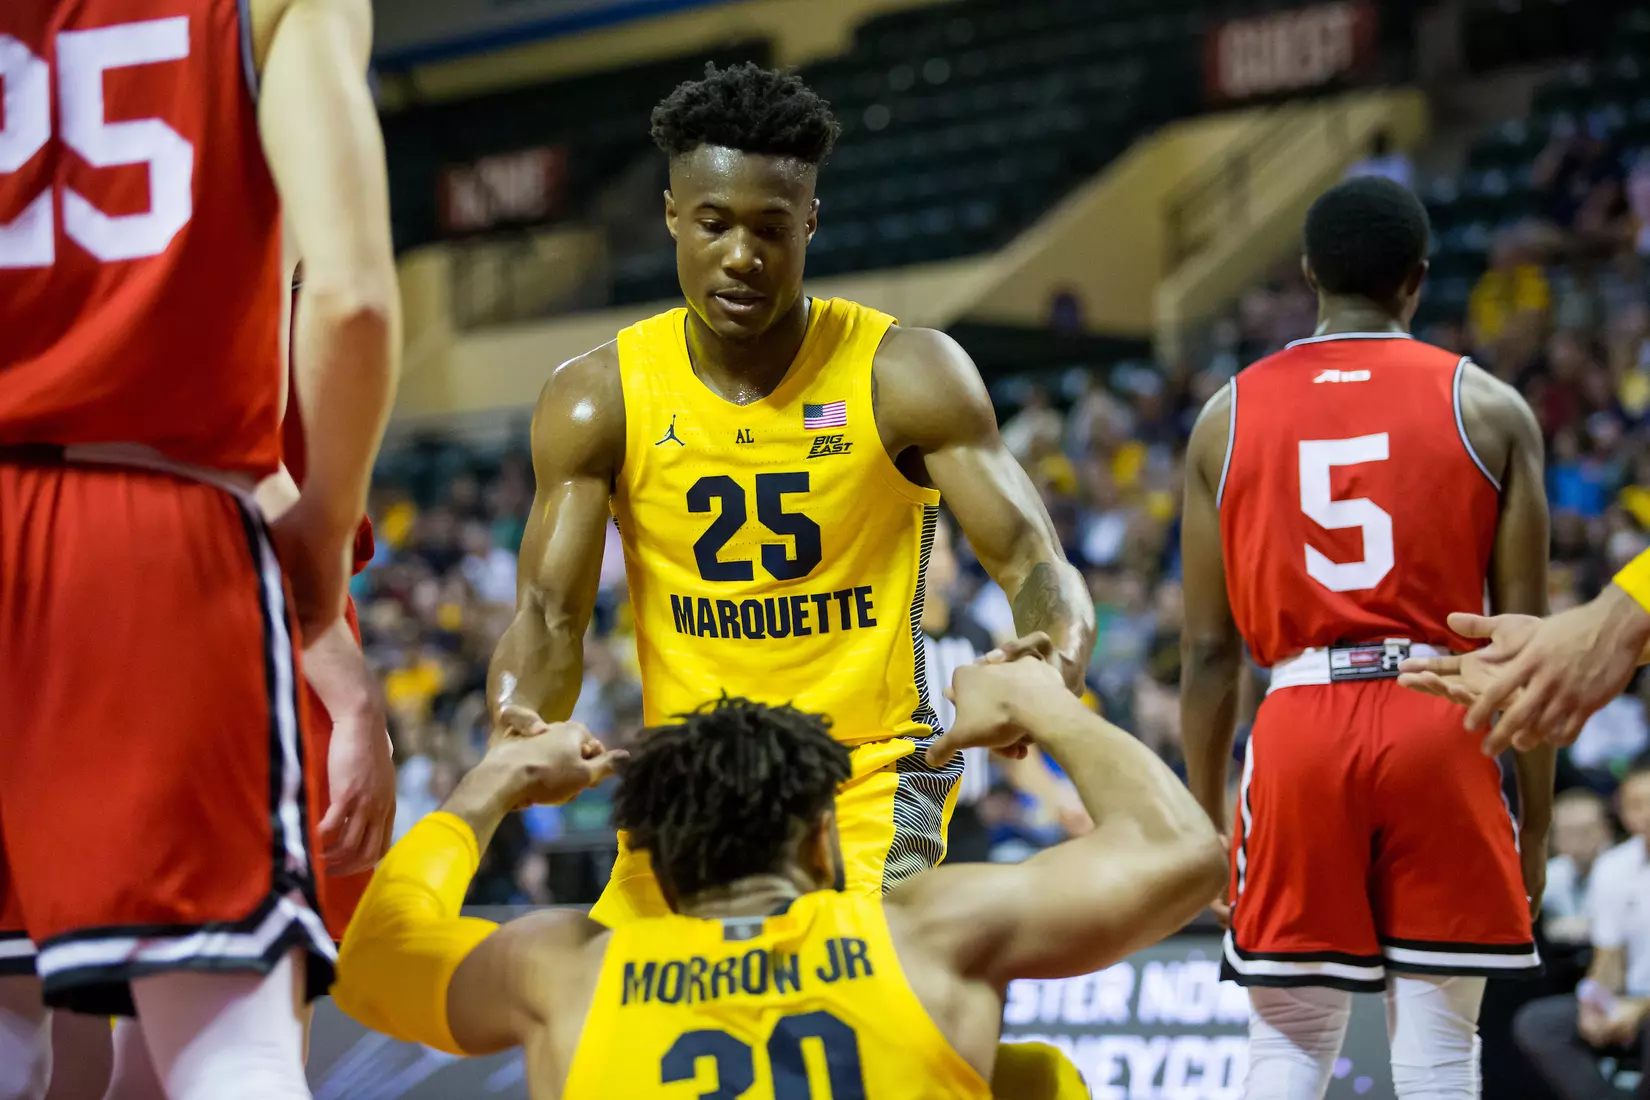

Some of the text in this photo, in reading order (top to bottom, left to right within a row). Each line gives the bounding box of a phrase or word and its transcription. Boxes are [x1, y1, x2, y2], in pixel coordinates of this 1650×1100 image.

[735, 428, 755, 444] AL
[809, 442, 854, 455] EAST
[813, 434, 844, 446] BIG
[686, 471, 823, 582] 25
[1298, 432, 1395, 592] 5
[670, 585, 878, 640] MARQUETTE
[621, 937, 874, 1006] MORROW JR
